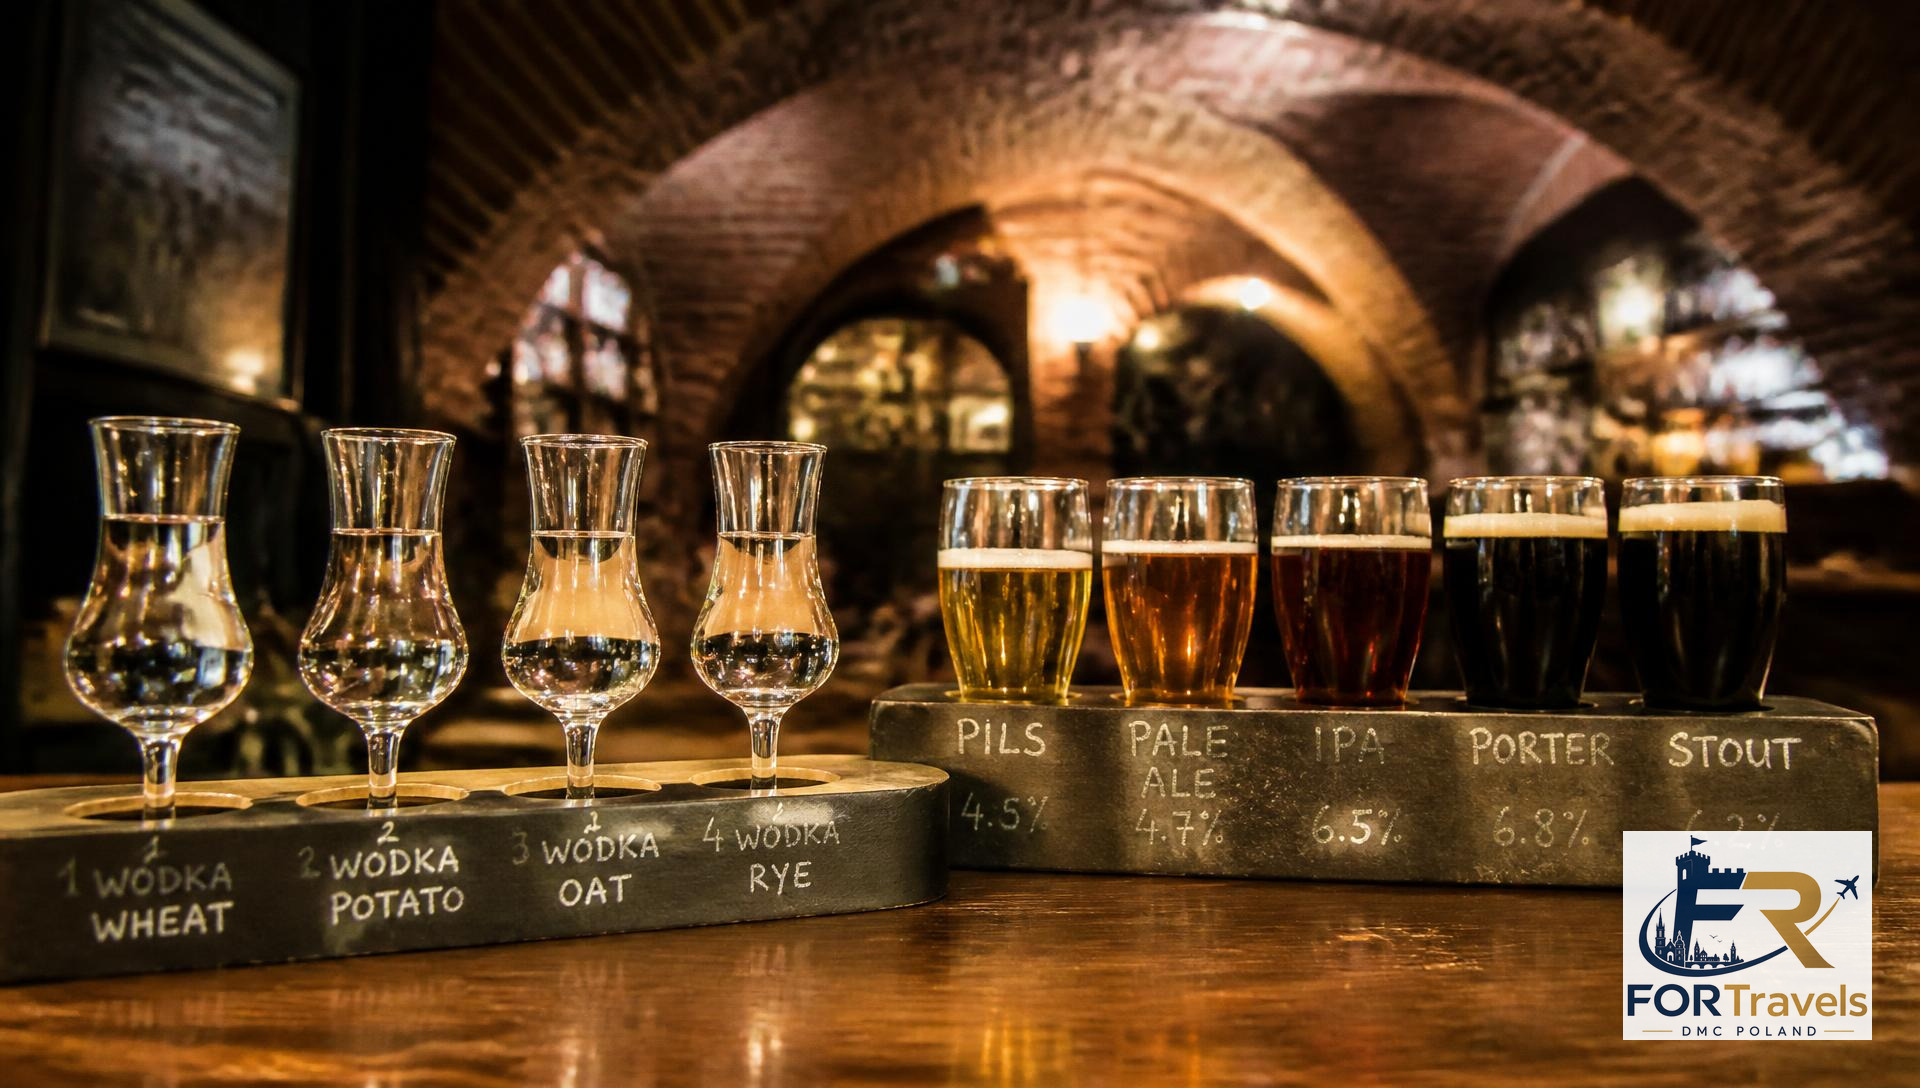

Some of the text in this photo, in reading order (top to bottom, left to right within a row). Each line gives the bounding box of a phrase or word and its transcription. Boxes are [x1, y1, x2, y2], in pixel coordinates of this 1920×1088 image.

[1128, 720, 1229, 758] PALE
[1315, 727, 1385, 764] IPA
[1469, 727, 1614, 766] PORTER
[1668, 732, 1802, 770] STOUT
[1141, 766, 1216, 799] ALE
[961, 792, 1048, 832] 4.5%
[1135, 808, 1223, 847] 4.7%
[1312, 805, 1402, 845] 6.5%
[1493, 806, 1589, 848] 6.8%
[512, 831, 530, 865] 3
[703, 817, 724, 852] 4
[559, 873, 632, 906] OAT
[750, 861, 811, 895] RYE
[91, 901, 234, 943] WHEAT
[331, 886, 464, 925] POTATO
